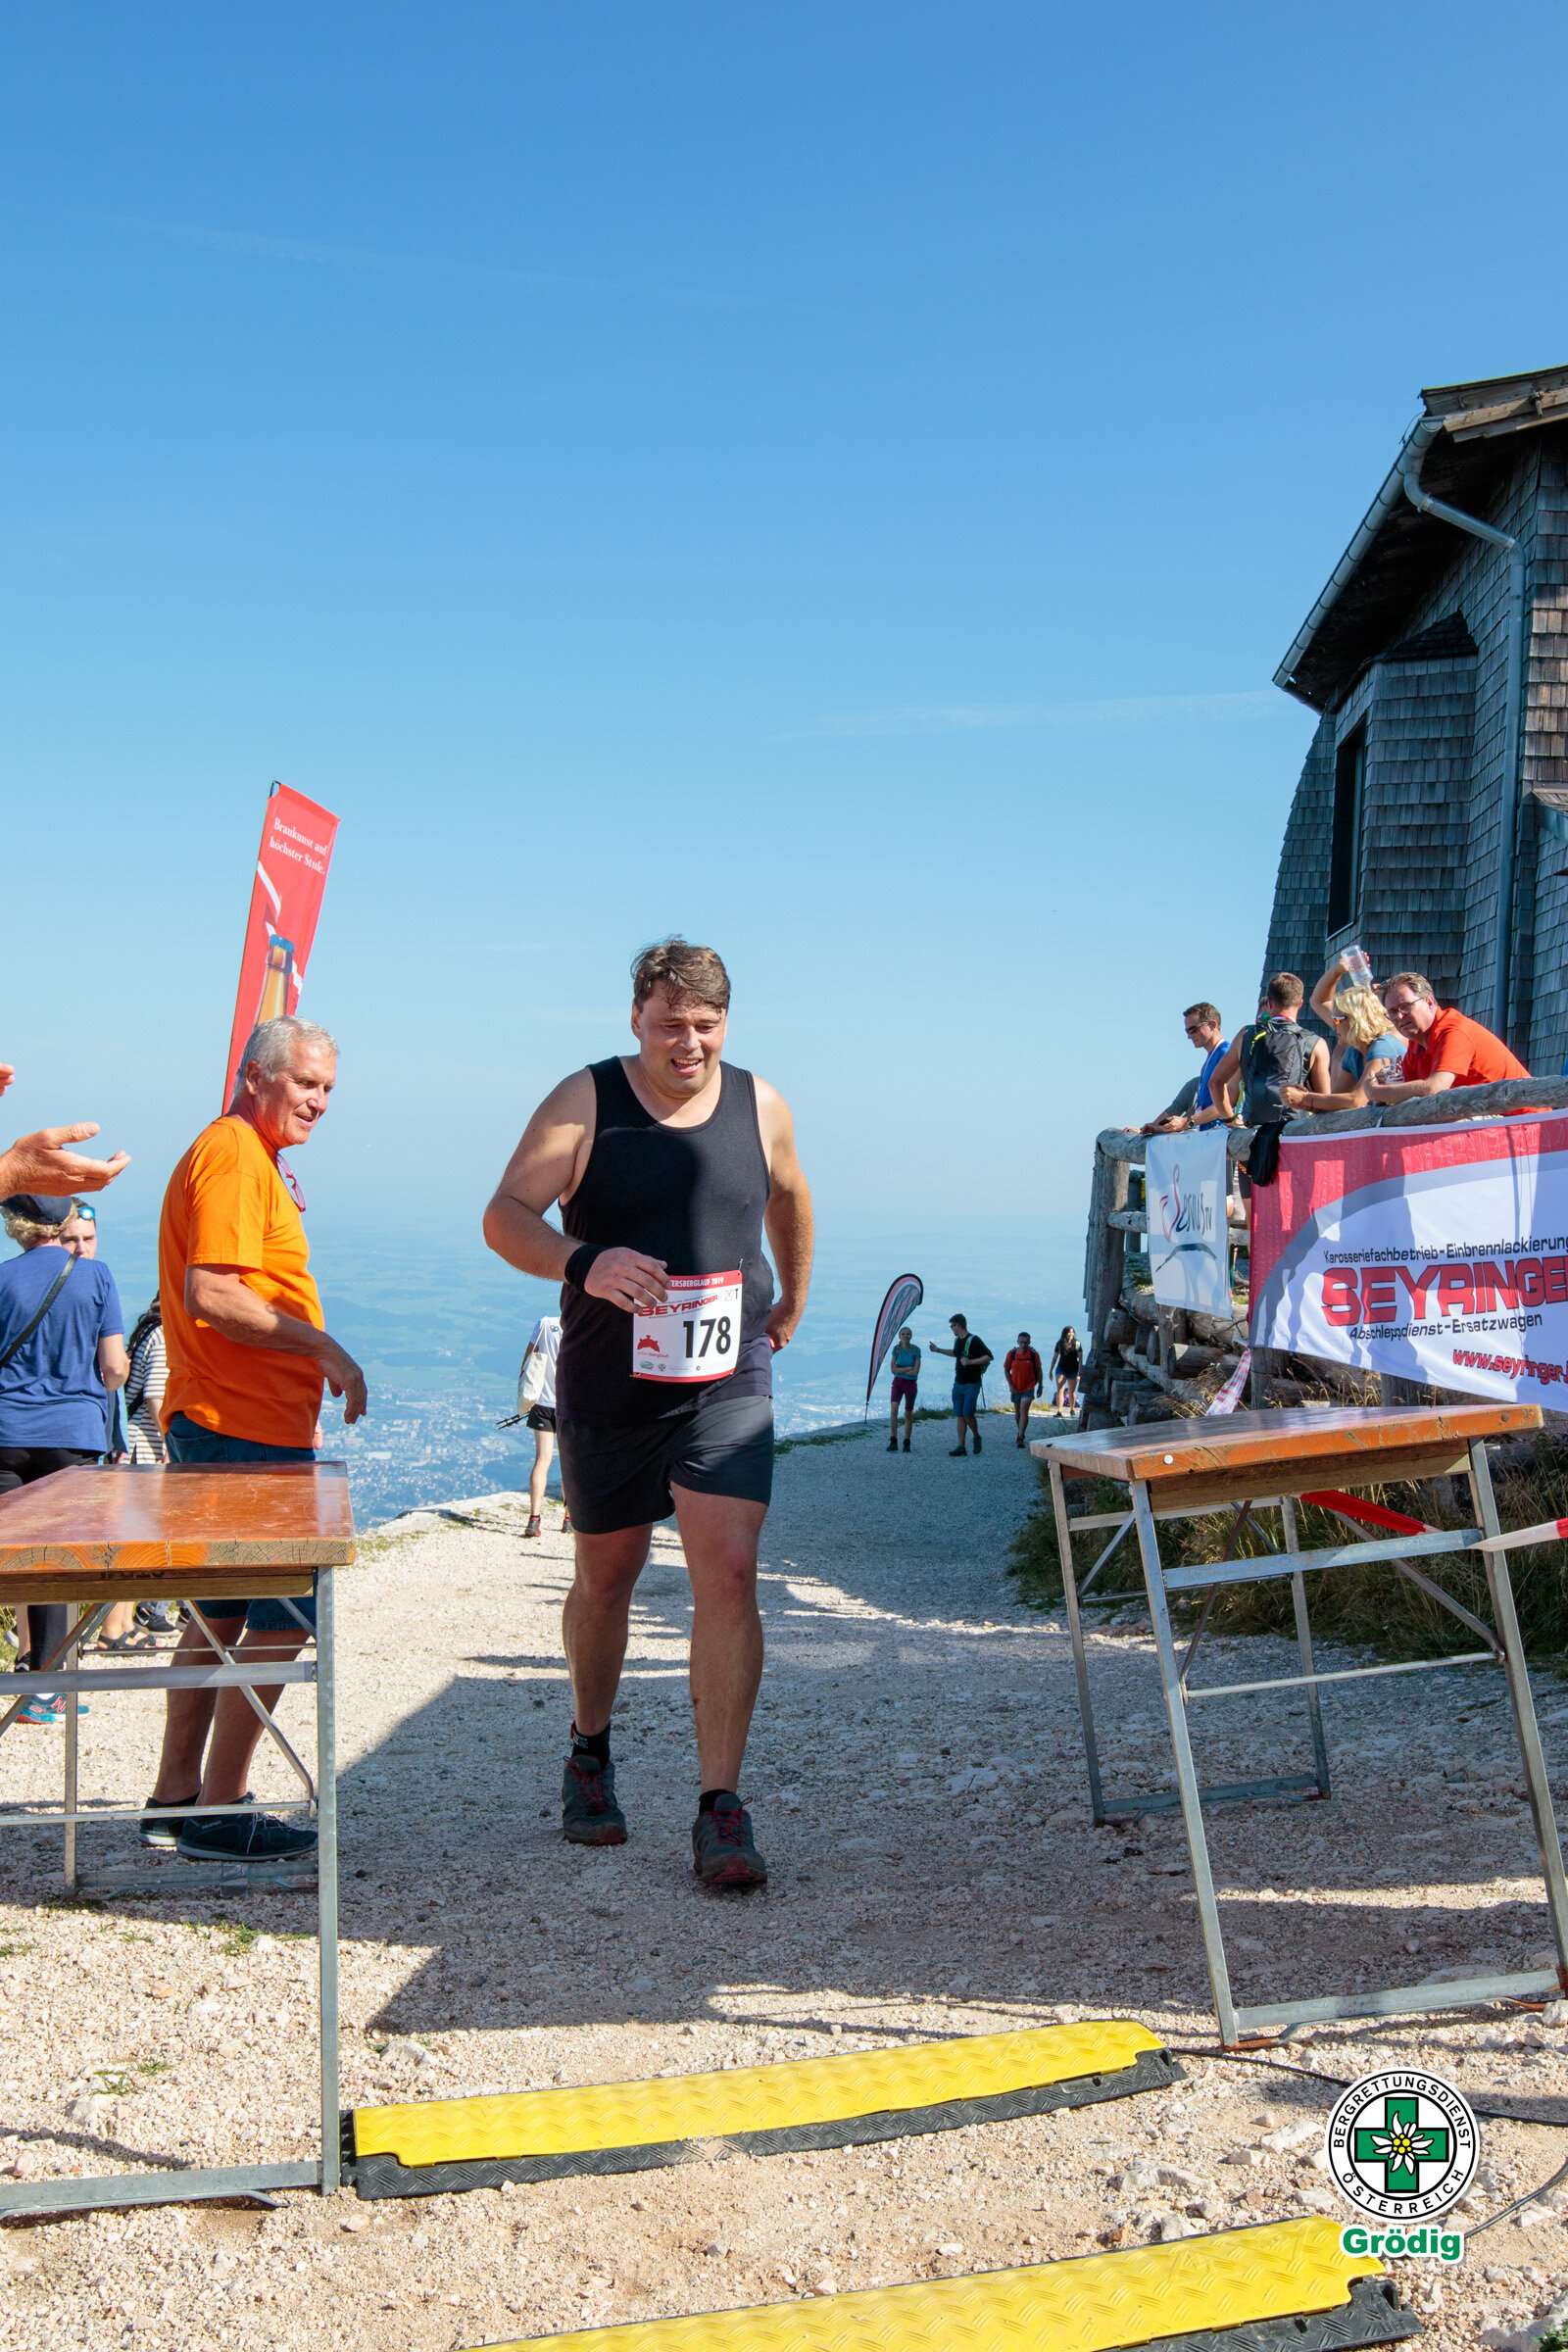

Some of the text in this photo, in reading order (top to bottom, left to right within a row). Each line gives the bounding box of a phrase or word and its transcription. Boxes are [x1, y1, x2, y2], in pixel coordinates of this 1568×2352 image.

[270, 836, 325, 874] höchster Stufe.
[274, 817, 328, 856] Braukunst auf
[1324, 1236, 1568, 1263] Karosseriefachbetrieb-Einbrennlackierun
[670, 1278, 710, 1288] ERSBERGLAUF
[1321, 1254, 1568, 1327] SEYRINGE
[682, 1315, 731, 1358] 178
